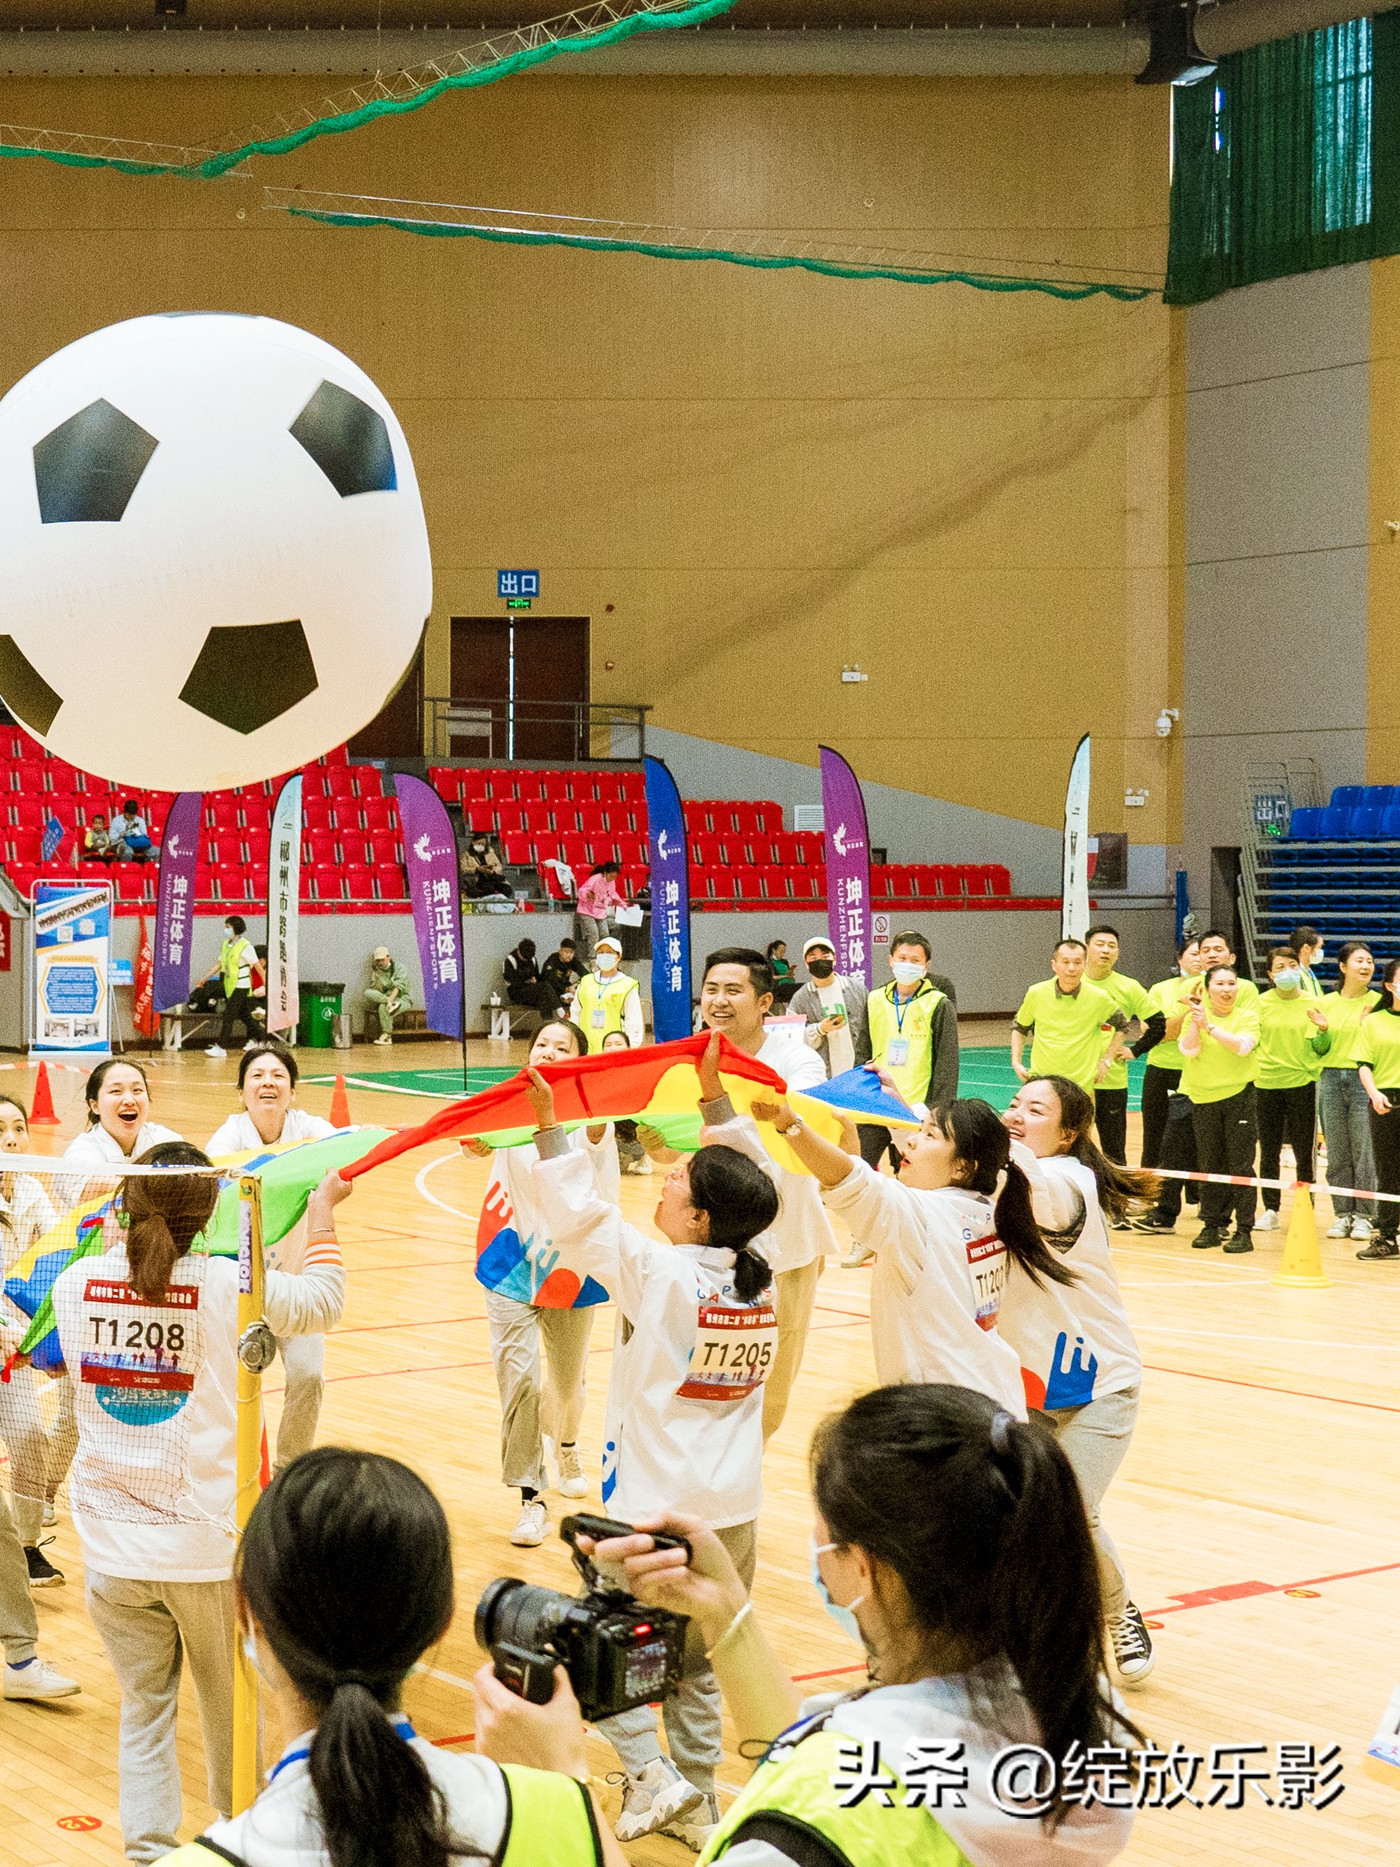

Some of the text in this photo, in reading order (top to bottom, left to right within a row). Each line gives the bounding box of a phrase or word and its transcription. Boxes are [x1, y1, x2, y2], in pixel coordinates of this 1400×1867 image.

[501, 573, 536, 594] 出口
[170, 874, 188, 965] 坤正体育
[432, 878, 459, 984] 坤正体育
[666, 880, 682, 992] 坤正体育
[89, 1317, 184, 1351] T1208
[703, 1342, 772, 1367] T1205
